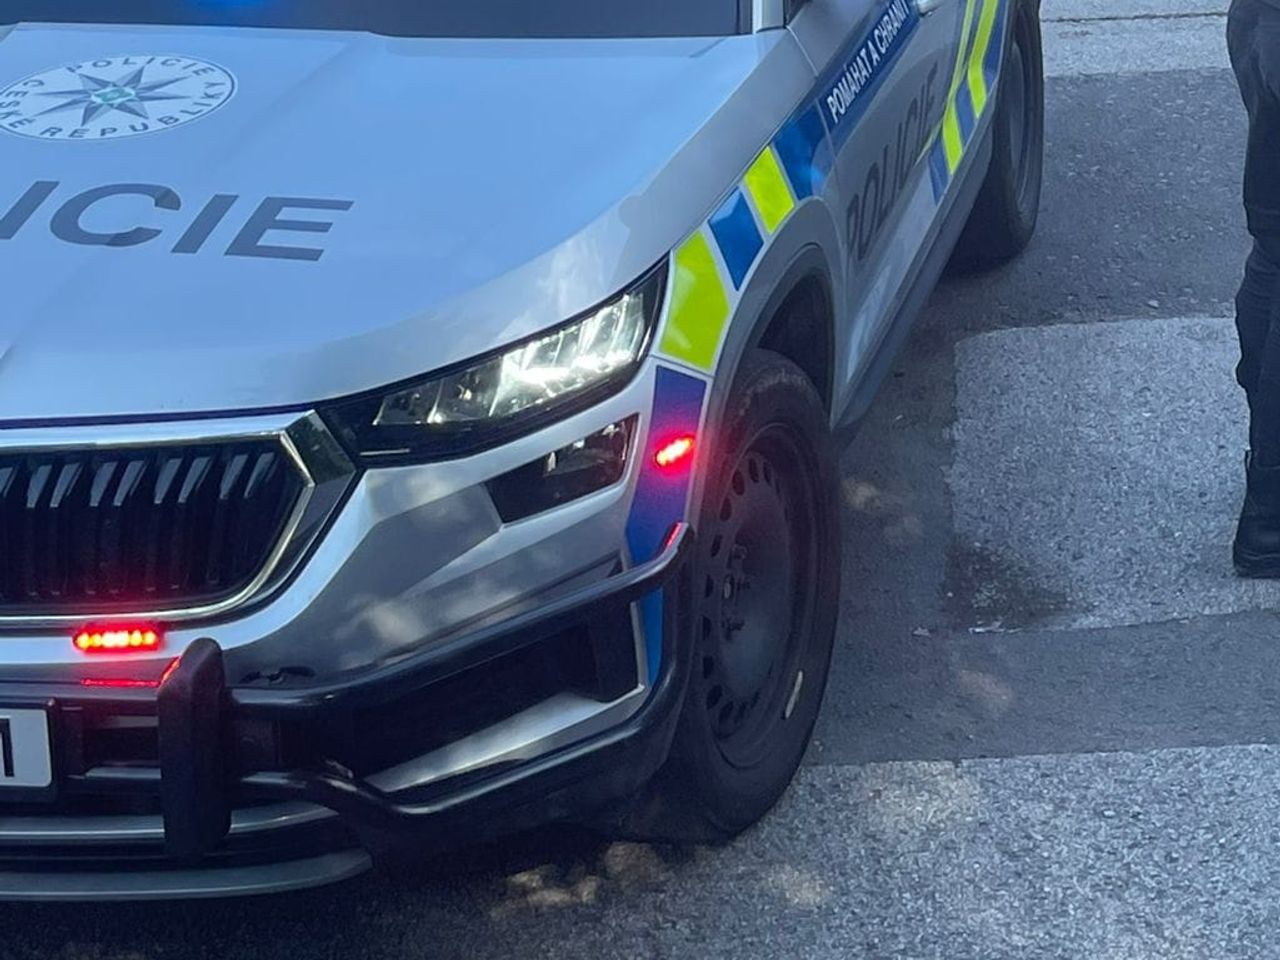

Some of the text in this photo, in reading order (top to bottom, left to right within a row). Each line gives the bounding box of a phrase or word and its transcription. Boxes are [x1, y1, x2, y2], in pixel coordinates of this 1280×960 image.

[66, 56, 216, 77] POLICIE
[827, 48, 872, 124] POMÁHAT
[868, 40, 880, 66] A
[39, 80, 227, 139] REPUBLIKY
[847, 61, 938, 262] POLICIE
